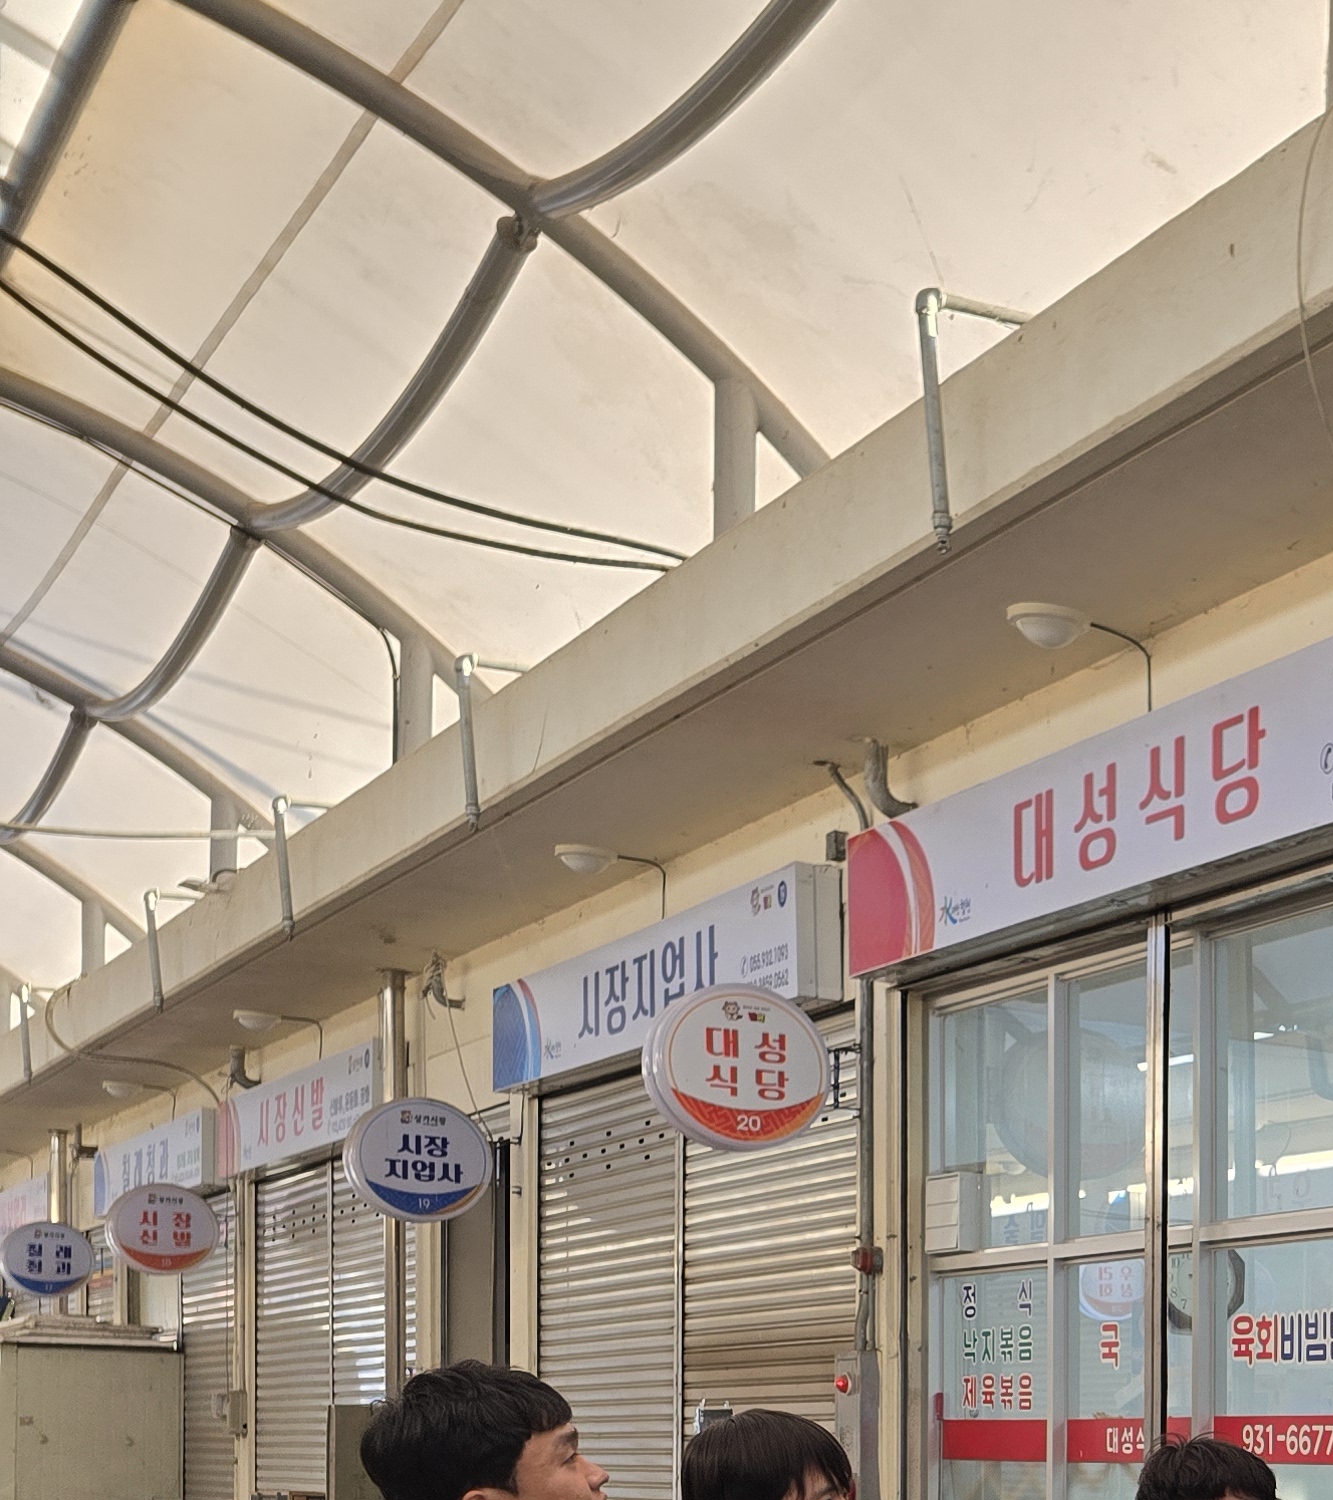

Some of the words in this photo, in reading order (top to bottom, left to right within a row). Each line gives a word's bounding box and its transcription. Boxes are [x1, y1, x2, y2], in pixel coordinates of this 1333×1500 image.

[1012, 705, 1267, 888] 대성식당
[577, 924, 719, 1040] 시장지업사
[706, 1026, 787, 1064] 대성
[706, 1065, 789, 1101] 식당
[258, 1076, 325, 1147] 시장신발
[736, 1114, 762, 1132] 20
[397, 1133, 450, 1158] 시장
[385, 1157, 463, 1184] 지업사
[418, 1198, 430, 1209] 19
[962, 1324, 1034, 1366] 낙지볶음
[1100, 1322, 1122, 1370] 국
[962, 1373, 1034, 1412] 제육볶음
